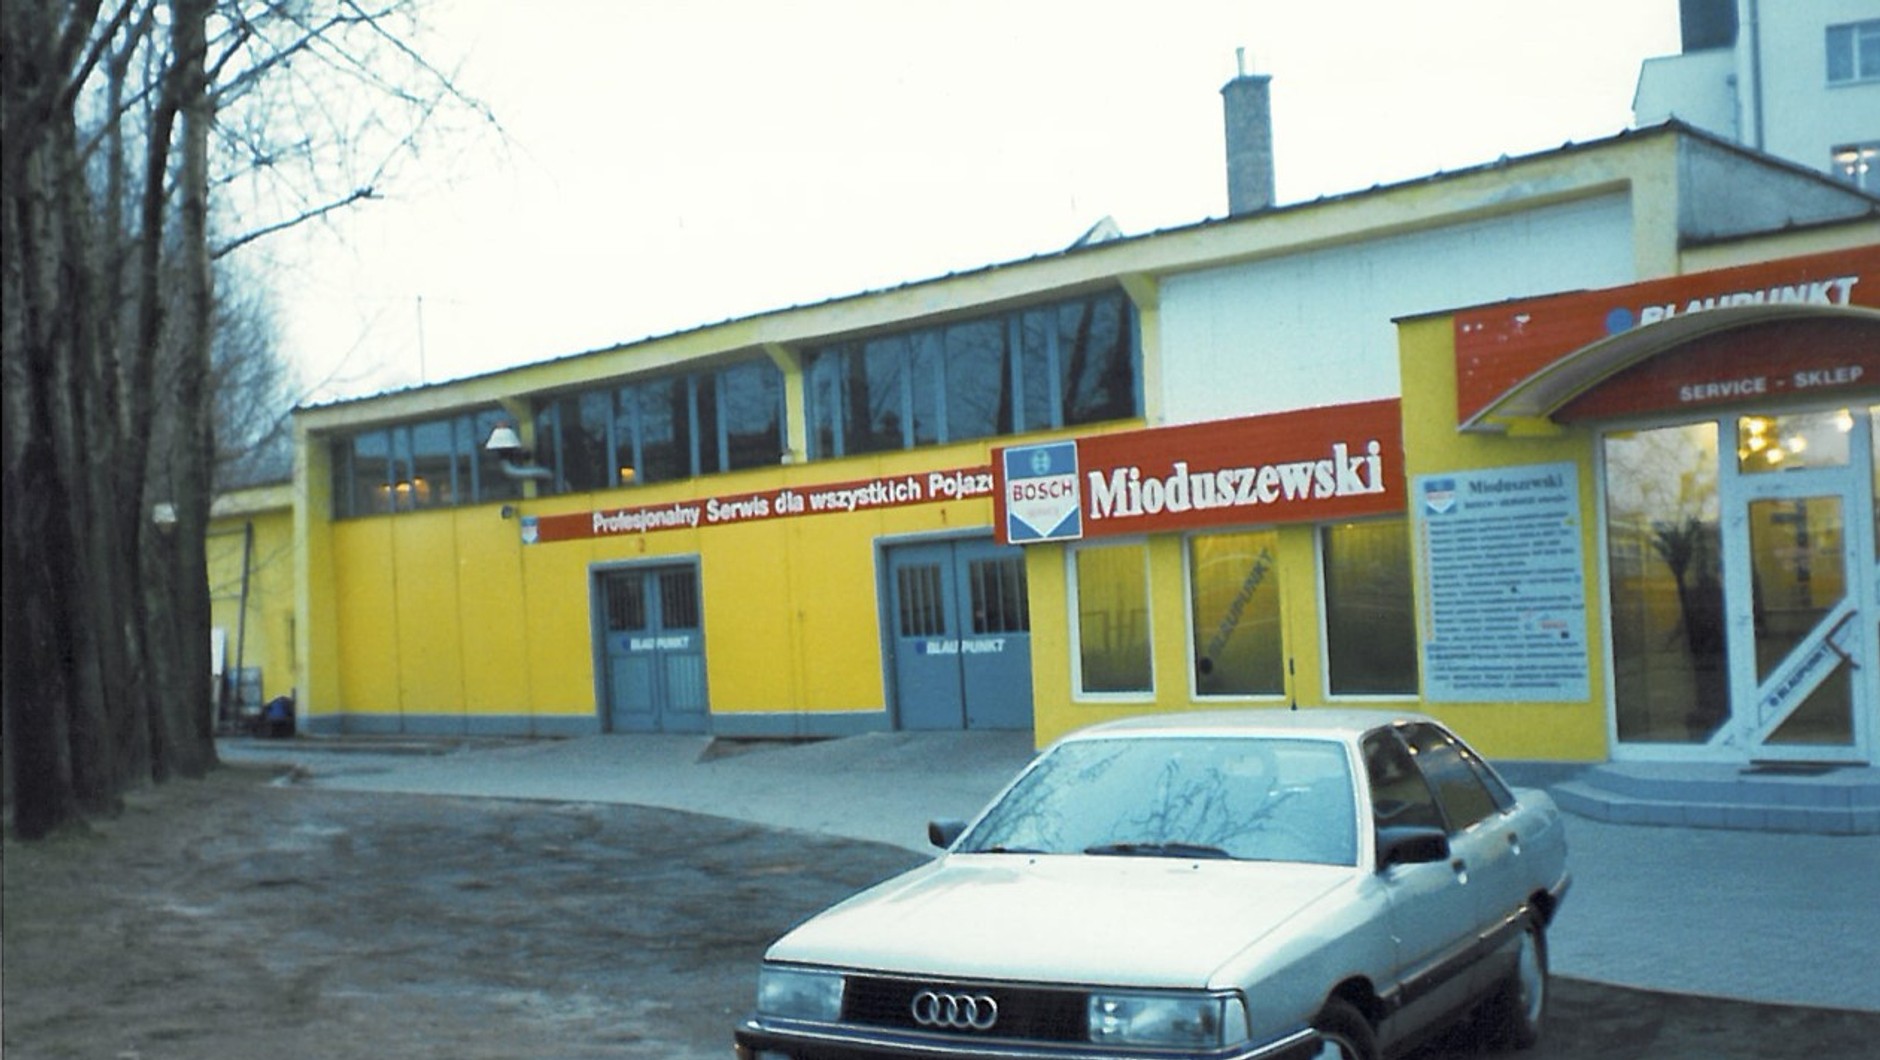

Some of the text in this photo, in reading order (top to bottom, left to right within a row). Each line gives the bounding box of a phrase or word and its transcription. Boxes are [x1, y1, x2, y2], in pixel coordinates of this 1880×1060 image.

[1680, 377, 1767, 402] SERVICE
[1793, 365, 1864, 388] SKLEP
[1012, 479, 1074, 502] BOSCH
[1088, 440, 1385, 520] Mioduszewski
[593, 504, 700, 533] Profesjonalny
[706, 496, 769, 522] Serwis
[775, 489, 804, 515] dla
[810, 477, 921, 512] wszystkich
